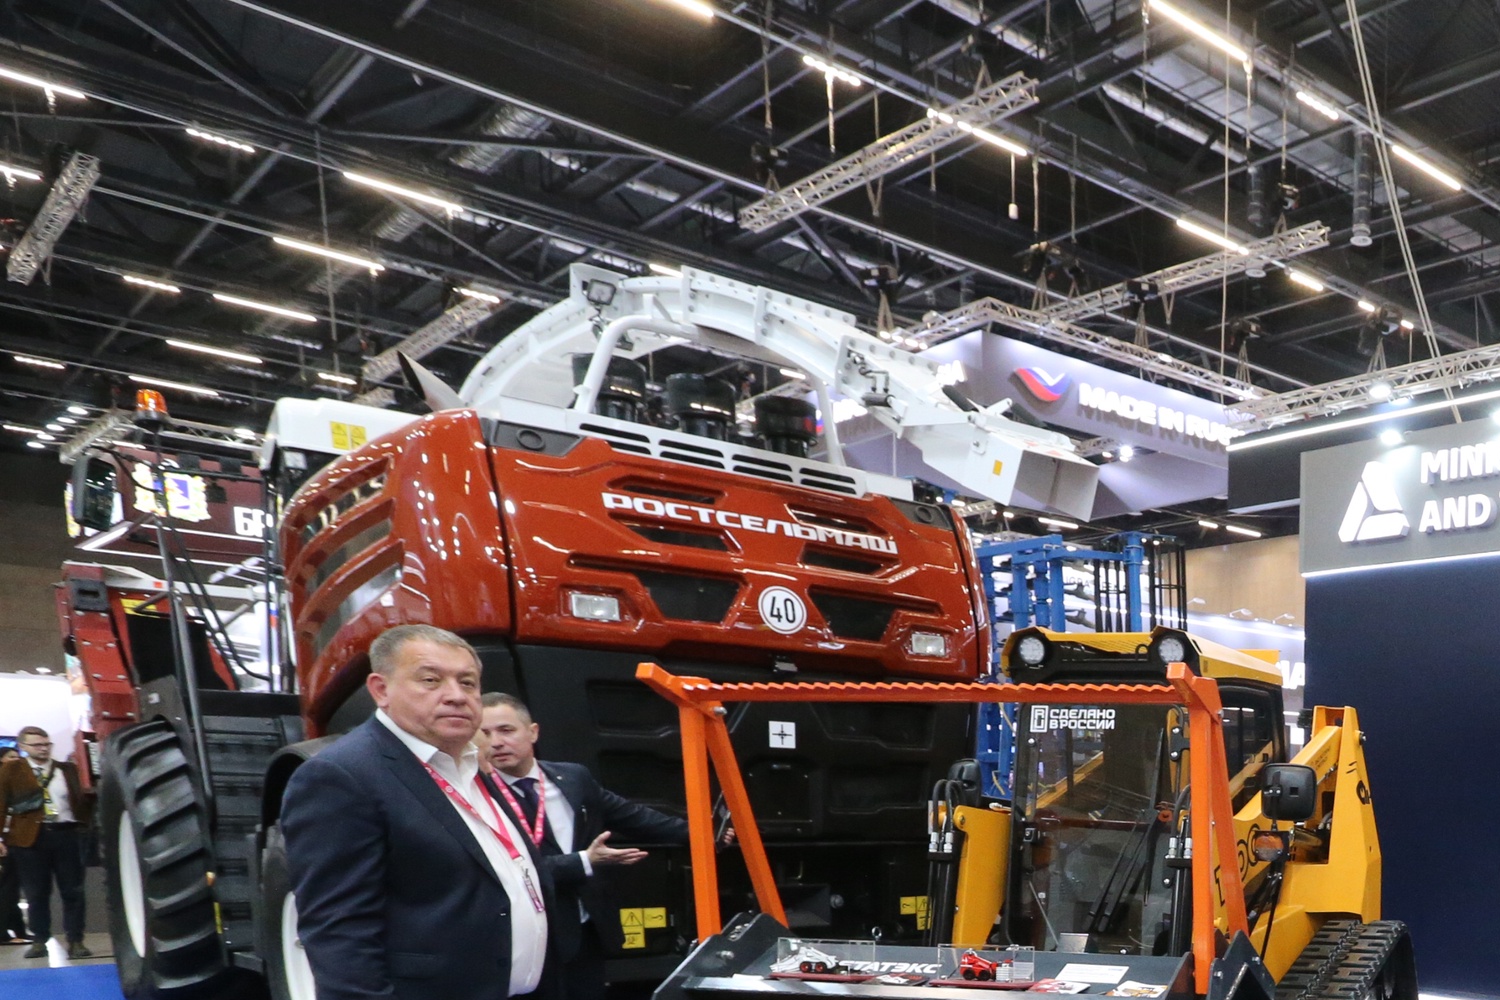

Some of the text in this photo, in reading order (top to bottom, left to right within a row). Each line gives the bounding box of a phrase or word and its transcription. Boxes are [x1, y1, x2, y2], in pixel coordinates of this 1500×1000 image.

[1078, 382, 1157, 425] MADE
[1158, 406, 1184, 432] IN
[601, 492, 899, 555] РОСТСЕЛЬМАШ
[1418, 497, 1495, 533] AND
[769, 596, 797, 624] 40
[1049, 709, 1116, 719] СДЕЛАНО
